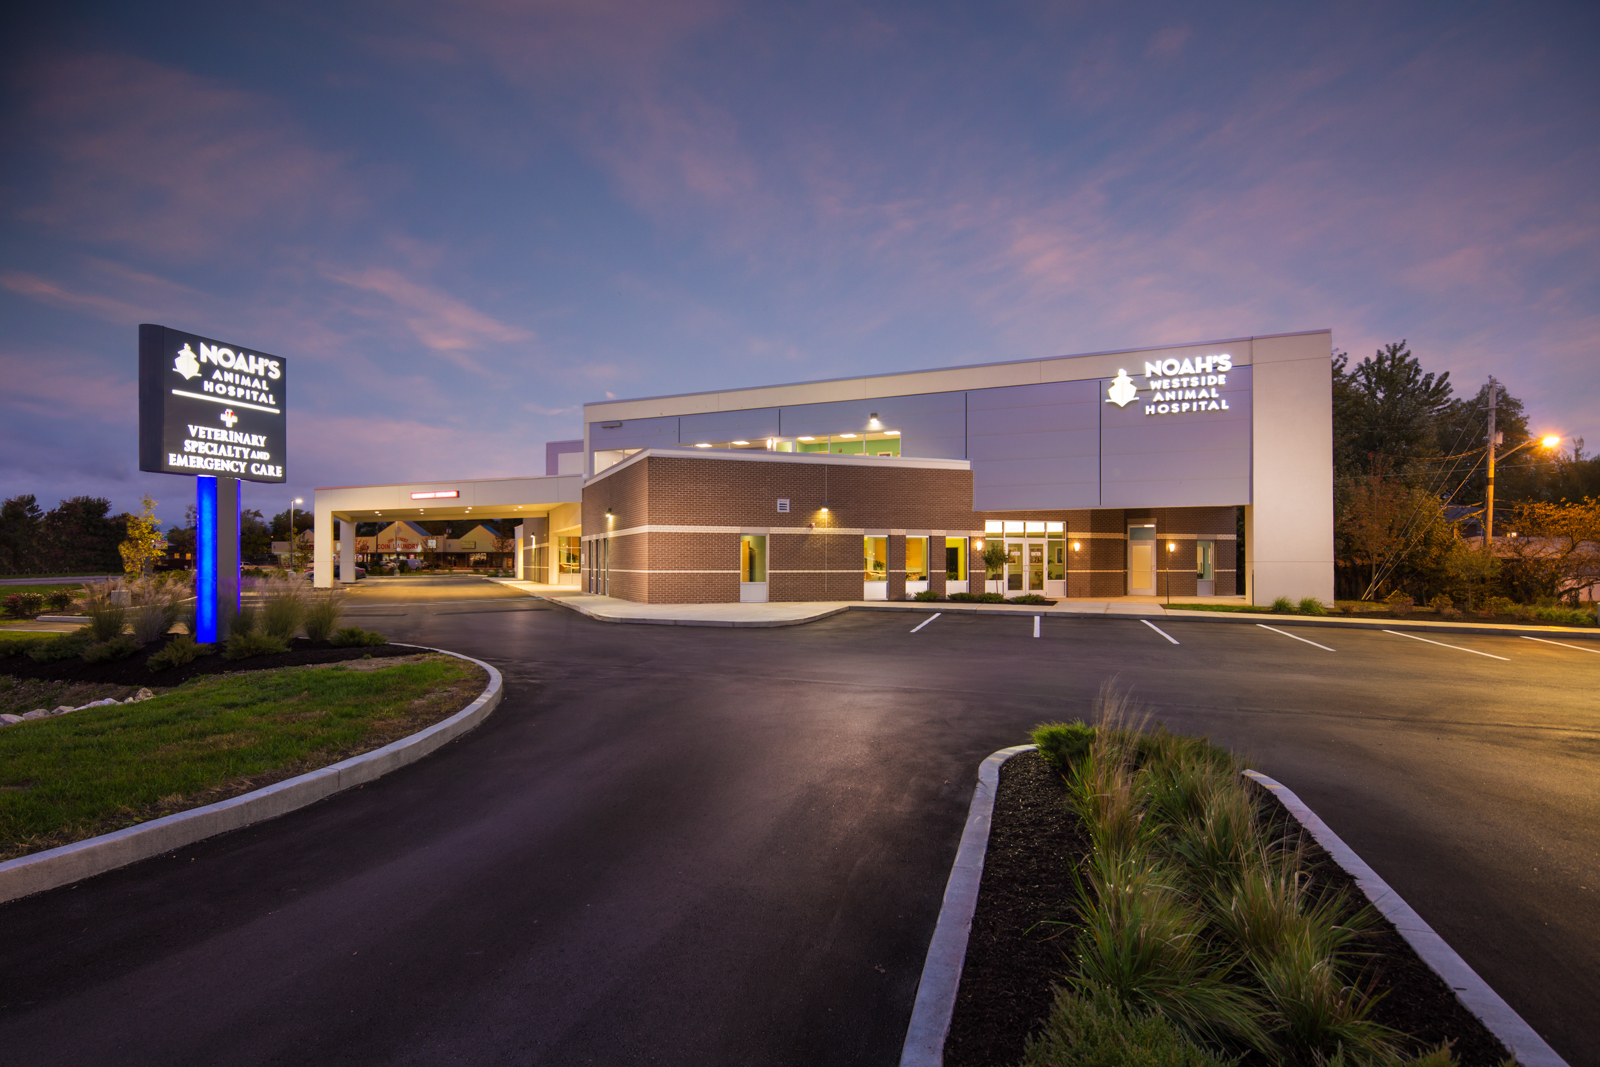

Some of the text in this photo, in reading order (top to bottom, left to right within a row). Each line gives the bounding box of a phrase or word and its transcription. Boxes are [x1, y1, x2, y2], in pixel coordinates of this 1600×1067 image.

[200, 342, 281, 379] NOAH'S
[1145, 354, 1232, 377] NOAH'S
[212, 369, 269, 391] ANIMAL
[1150, 374, 1226, 390] WESTSIDE
[203, 380, 276, 404] HOSPITAL
[1153, 388, 1219, 402] ANIMAL
[1145, 400, 1229, 415] HOSPITAL
[188, 425, 267, 446] VETERINARY
[183, 440, 270, 460] SPECIALTY AND
[168, 453, 283, 477] EMERGENCY CARE
